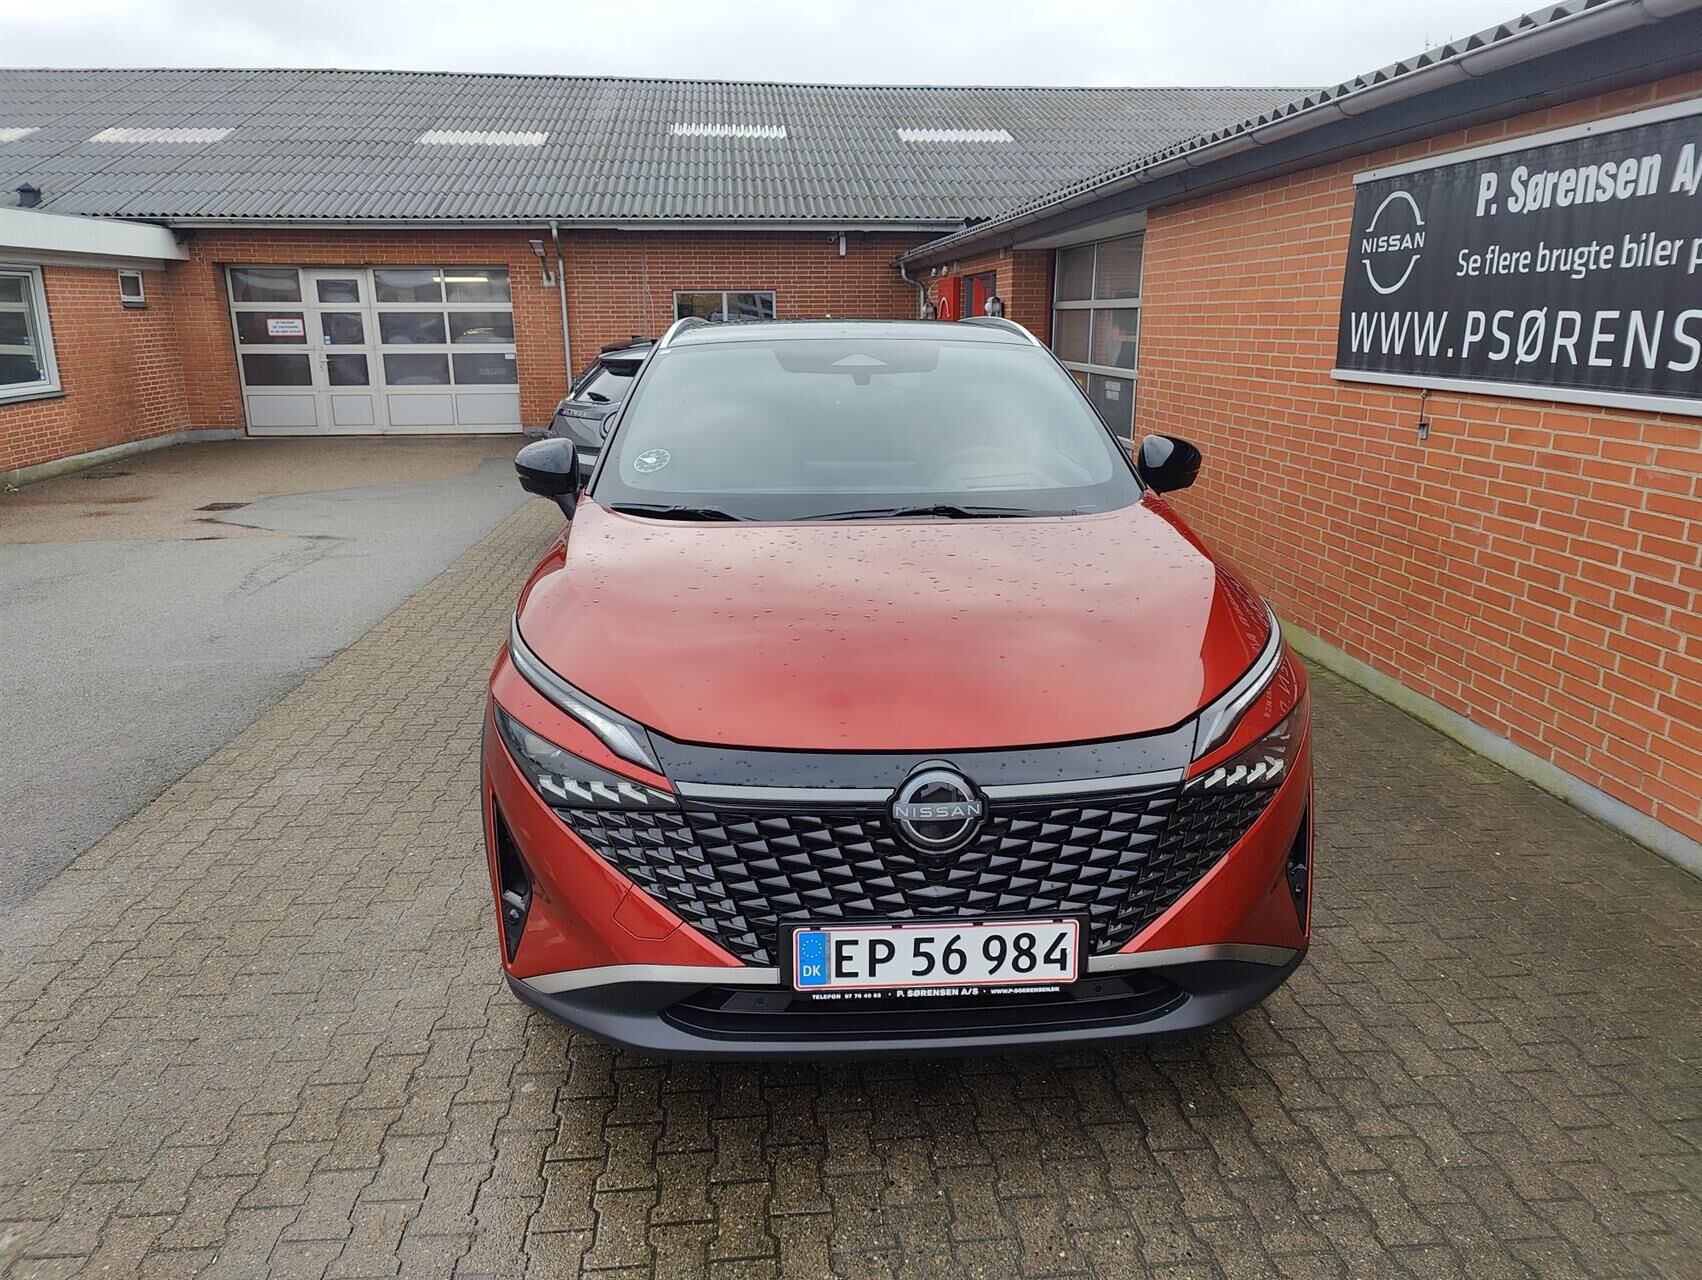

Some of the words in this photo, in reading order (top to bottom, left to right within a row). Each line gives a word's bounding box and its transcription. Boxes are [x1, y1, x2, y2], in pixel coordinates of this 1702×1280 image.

[1476, 171, 1498, 217] P.
[1507, 152, 1662, 214] Sørensen
[1361, 231, 1426, 254] NISSAN
[1456, 248, 1480, 277] Se
[1485, 248, 1530, 275] flere
[1536, 241, 1615, 279] brugte
[1619, 231, 1684, 268] biler
[895, 803, 980, 818] NISSAN
[835, 939, 896, 978] EP
[912, 934, 967, 976] 56
[982, 932, 1068, 975] 984
[803, 965, 821, 978] DK
[907, 988, 959, 997] SØRENSEN
[960, 987, 979, 996] A/S
